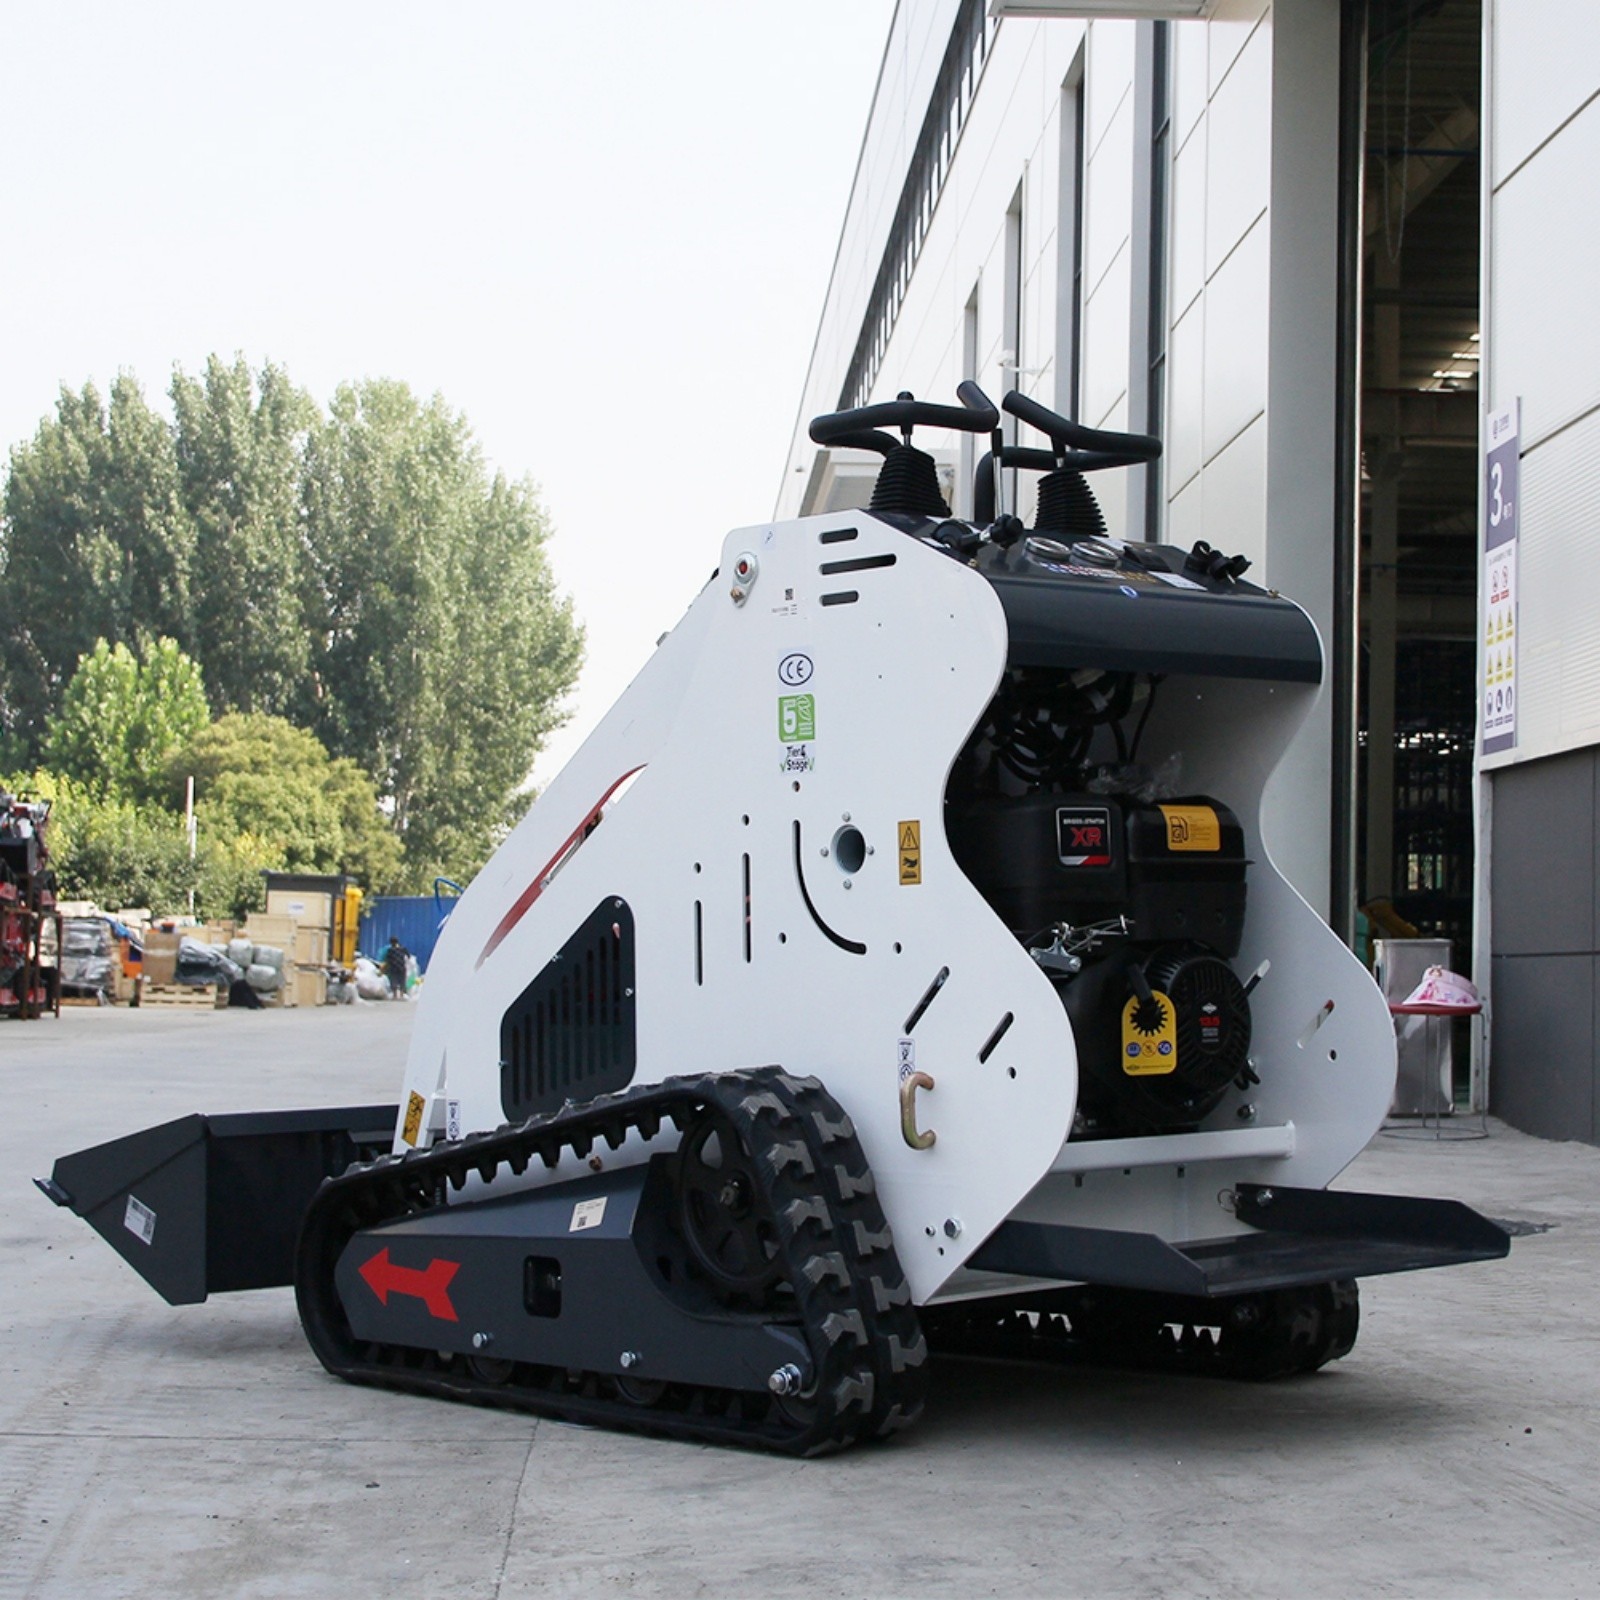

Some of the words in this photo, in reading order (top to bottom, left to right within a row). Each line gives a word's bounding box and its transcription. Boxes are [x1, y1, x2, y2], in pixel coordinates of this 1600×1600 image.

[1490, 462, 1503, 527] 3
[786, 660, 804, 680] CE
[1070, 826, 1101, 847] XR
